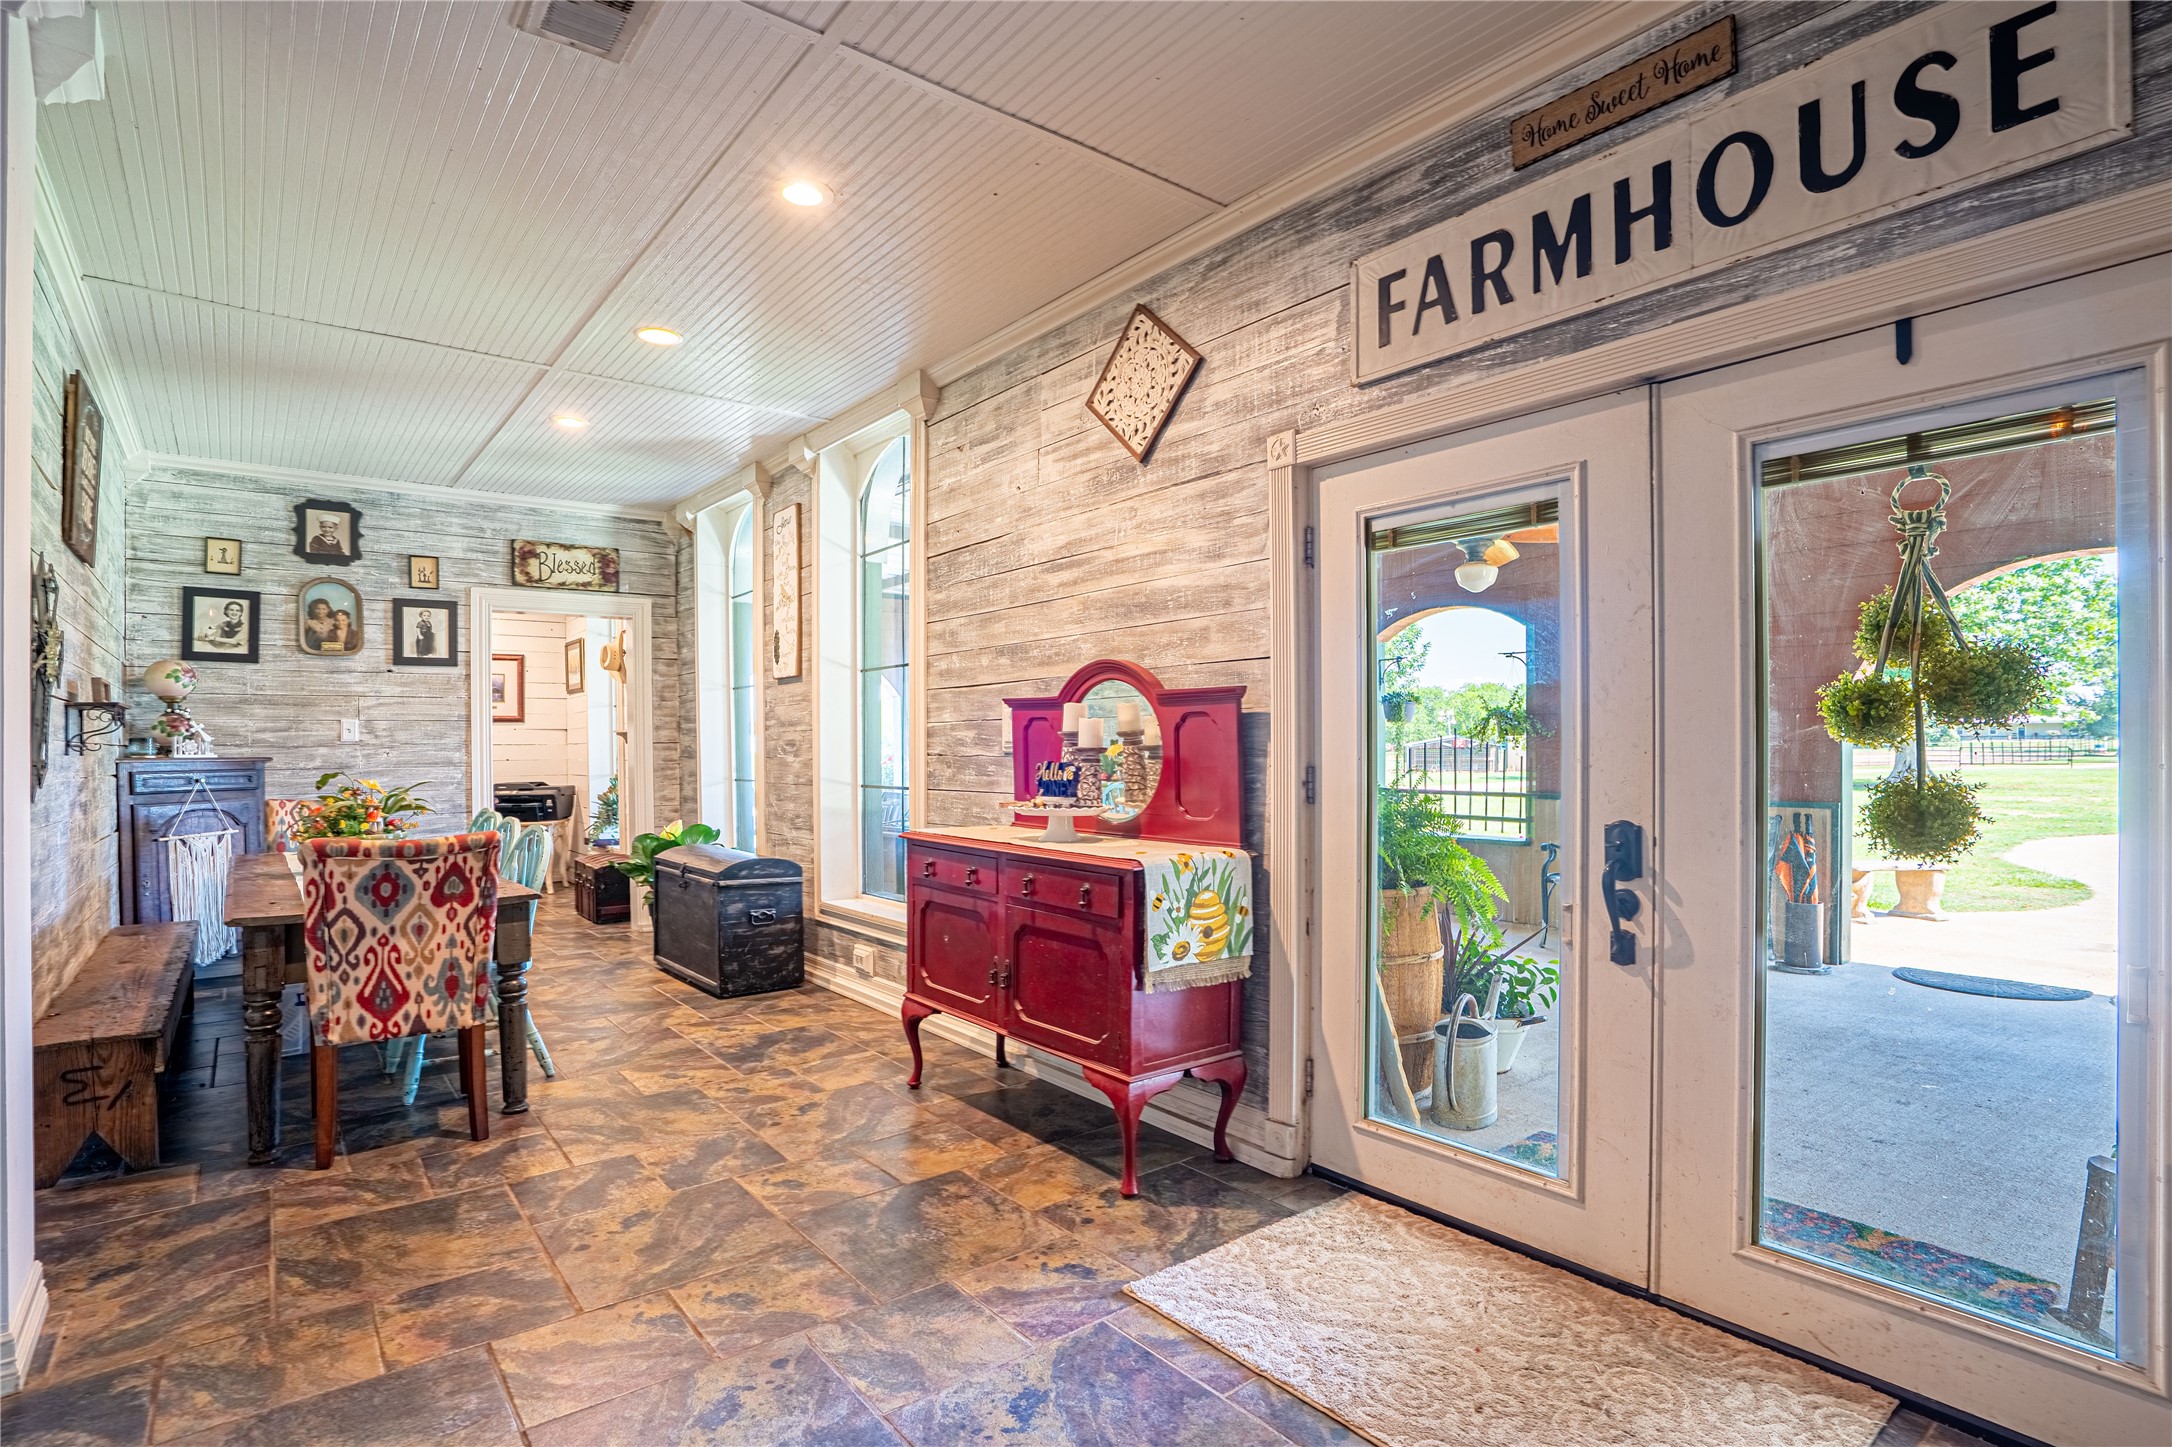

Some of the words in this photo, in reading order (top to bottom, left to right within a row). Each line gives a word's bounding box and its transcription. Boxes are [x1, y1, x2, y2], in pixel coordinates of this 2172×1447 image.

[1522, 114, 1580, 147] Home
[1585, 72, 1650, 124] Sweet
[1653, 44, 1722, 85] Home
[1378, 0, 2061, 349] FARMHOUSE
[536, 551, 597, 582] Blessed
[1035, 761, 1063, 781] Hello
